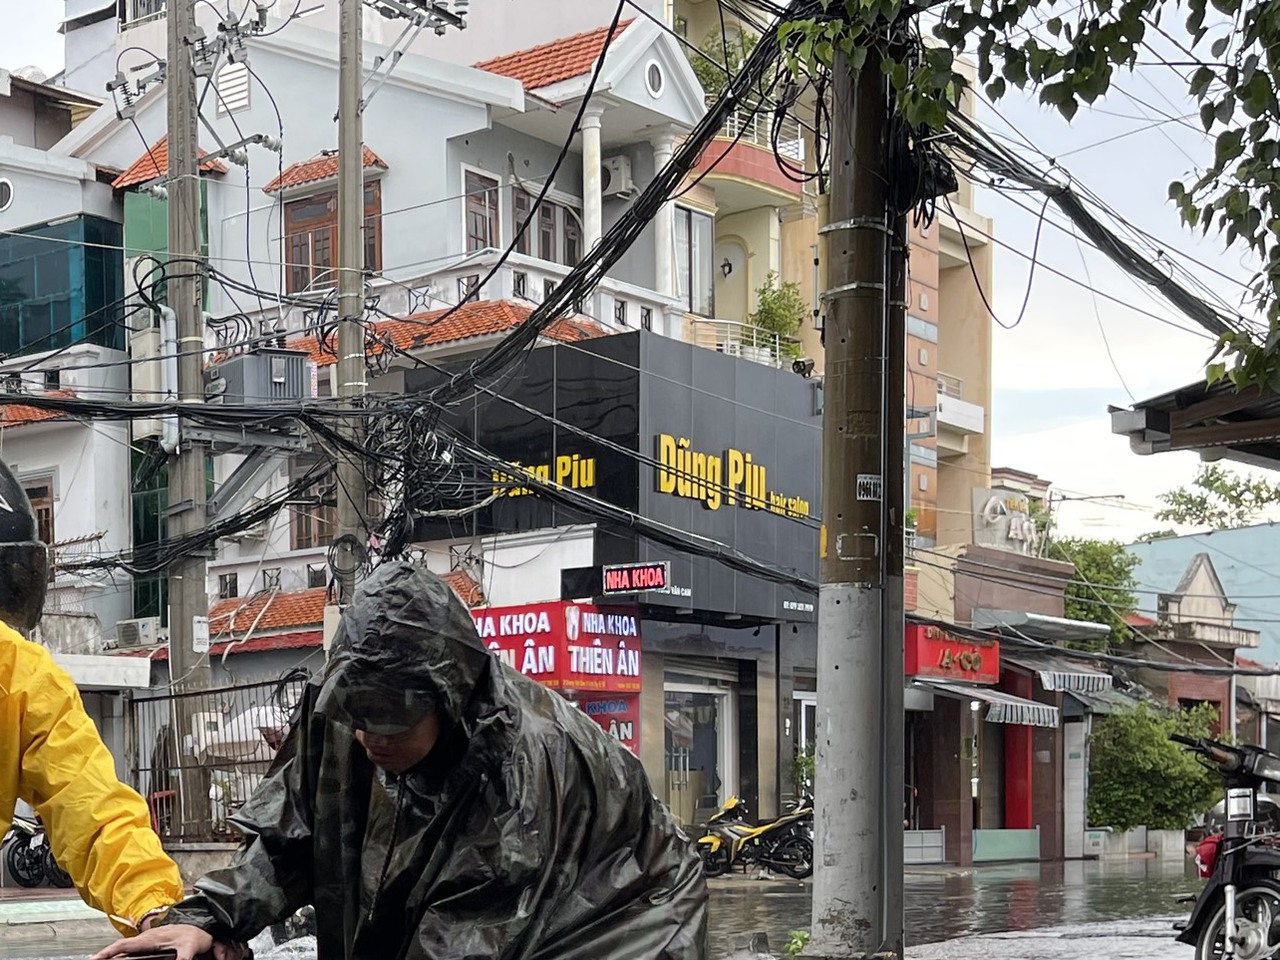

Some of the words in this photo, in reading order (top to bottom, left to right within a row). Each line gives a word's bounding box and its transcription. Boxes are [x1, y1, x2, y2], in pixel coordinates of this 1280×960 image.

[556, 454, 594, 490] Piu
[660, 433, 721, 510] Dũng
[728, 448, 766, 510] Piu
[606, 570, 630, 590] NHA
[632, 566, 664, 587] KHOA
[473, 617, 496, 637] HA
[500, 612, 551, 636] KHOA
[582, 612, 606, 634] NHA
[607, 614, 637, 637] KHOA
[521, 638, 555, 675] ÂN
[568, 638, 613, 675] THIÊN
[617, 641, 639, 676] ÂN
[586, 700, 628, 715] KHOA
[608, 719, 633, 740] ÂN
